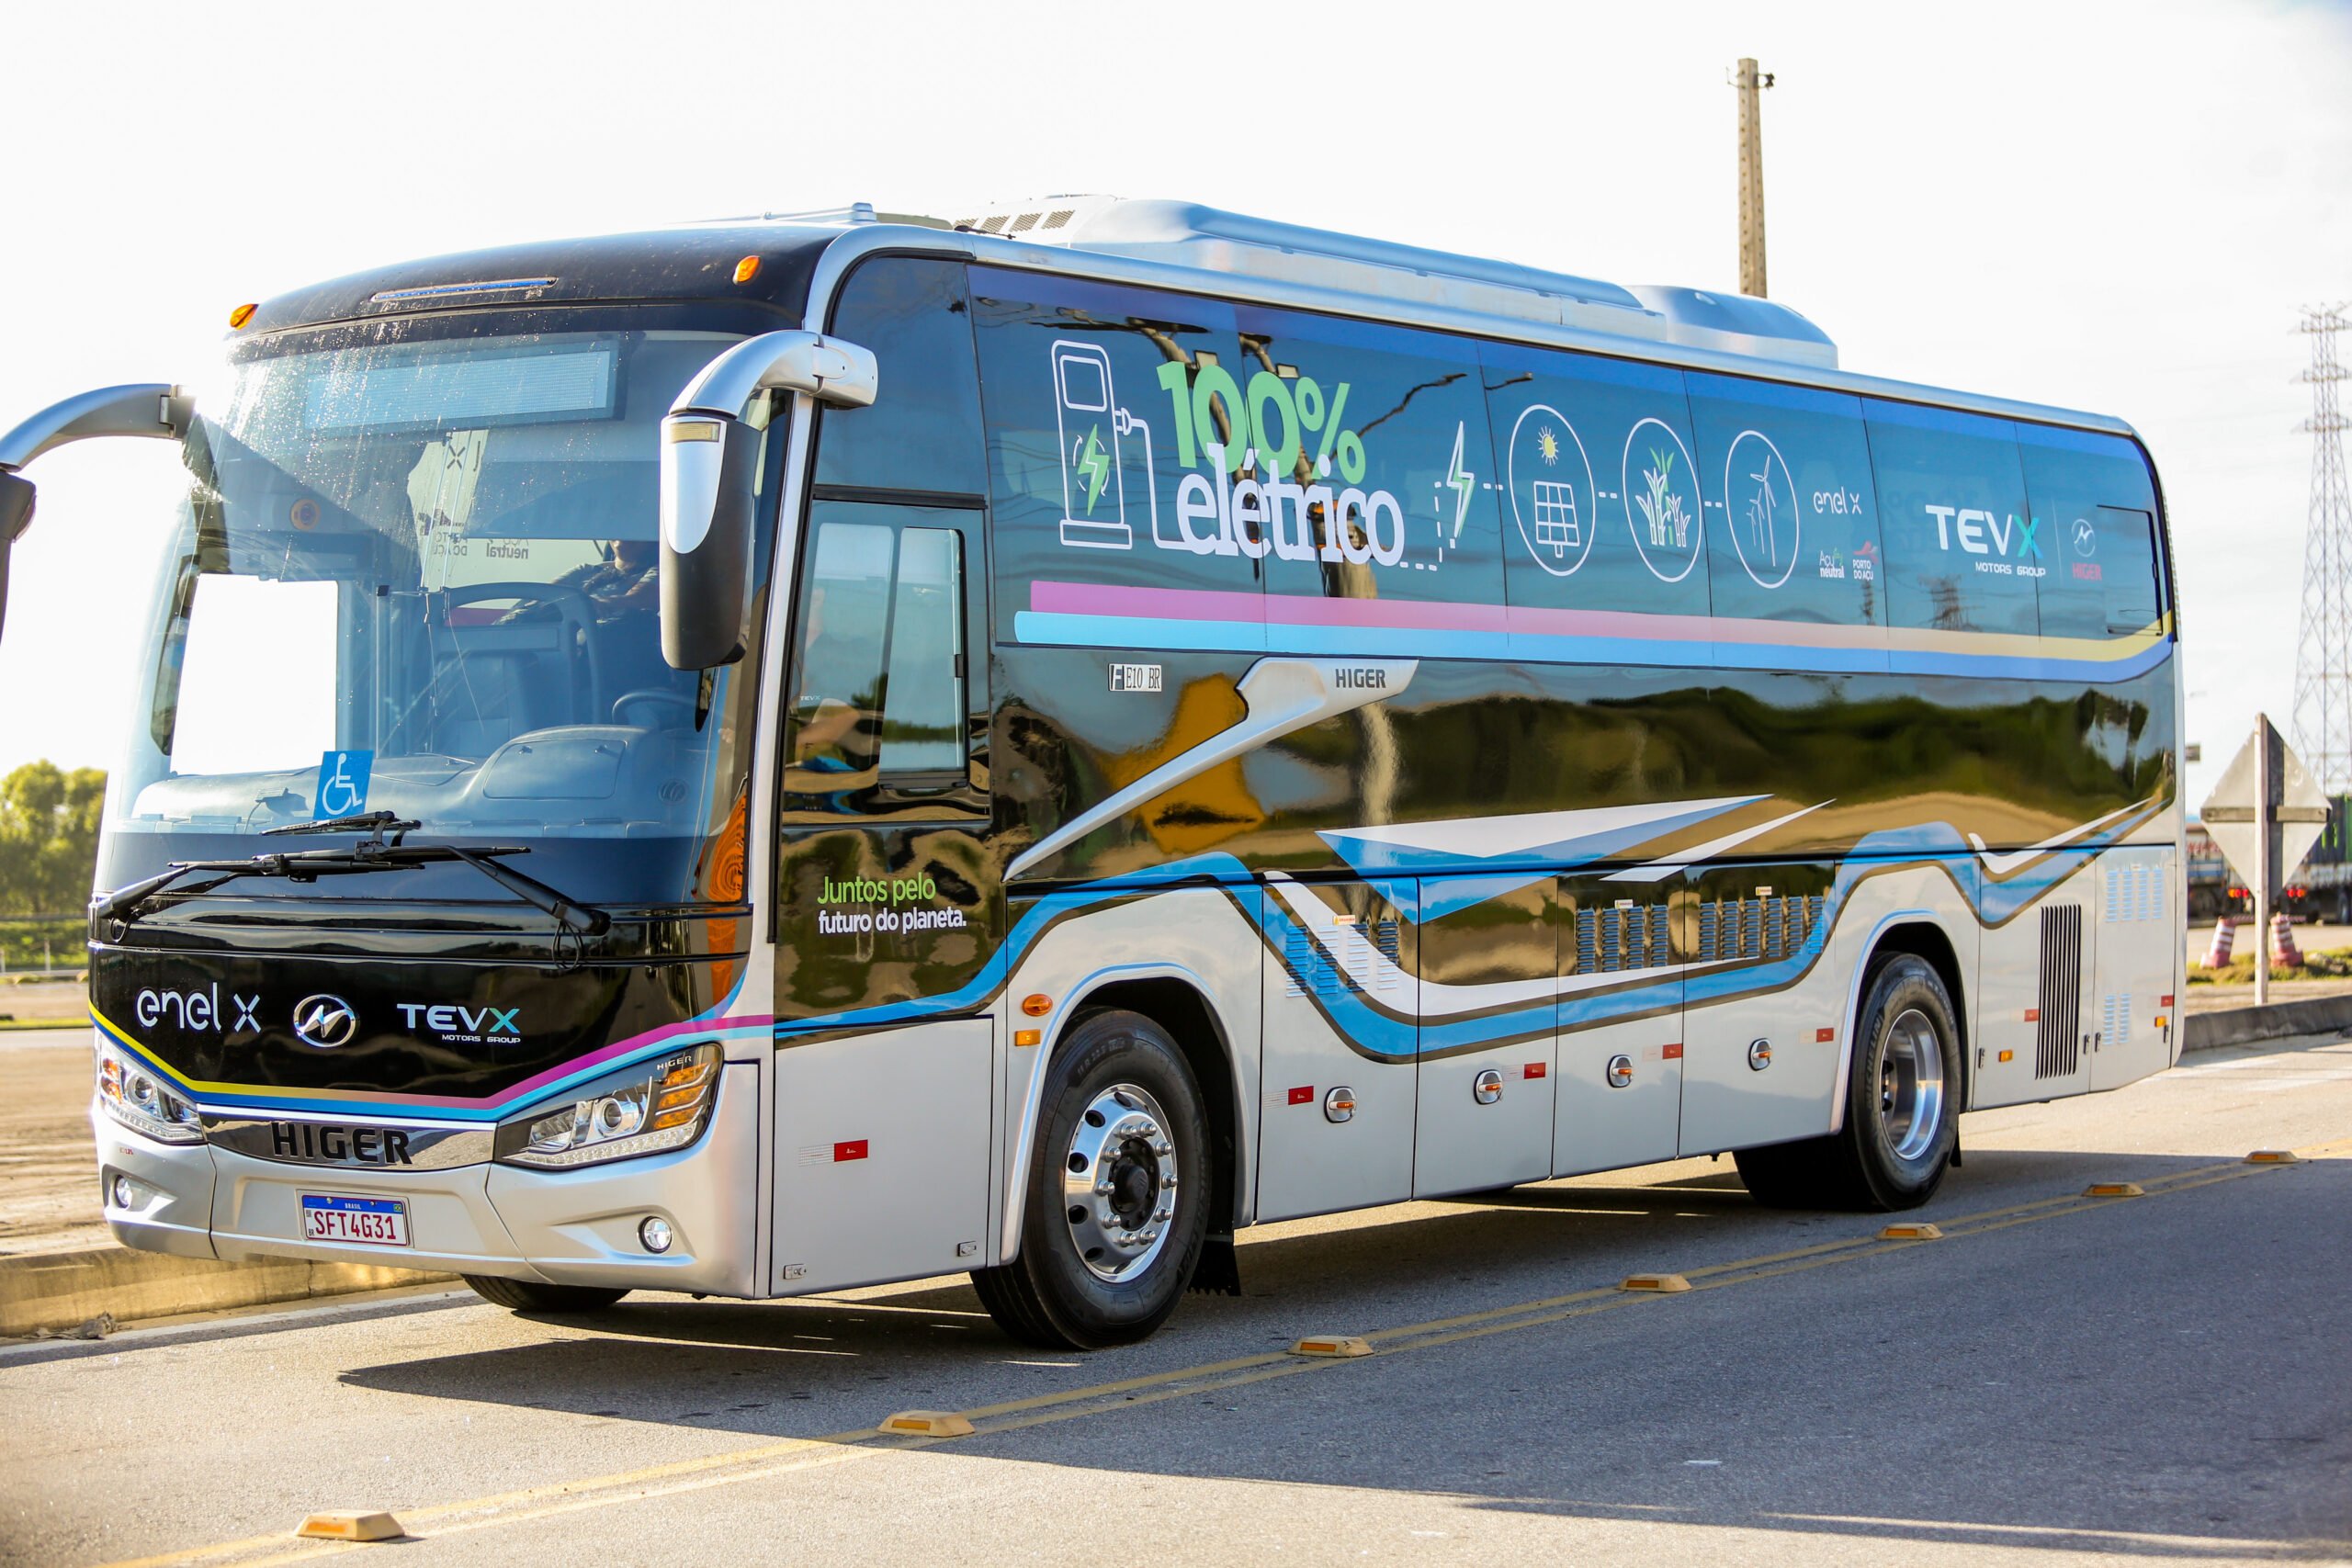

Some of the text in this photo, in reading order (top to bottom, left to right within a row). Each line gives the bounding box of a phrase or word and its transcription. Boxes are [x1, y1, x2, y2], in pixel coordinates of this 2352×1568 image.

[1157, 361, 1366, 484] 100%
[1177, 442, 1405, 567] elétrico
[1814, 486, 1848, 514] enel
[1926, 504, 2043, 558] TEVX
[1820, 566, 1845, 579] neutral
[1853, 559, 1871, 570] PORTO
[1854, 570, 1862, 580] DO
[1975, 562, 2046, 578] MOTORS GROUP
[2072, 562, 2102, 581] HIGER
[1148, 667, 1159, 689] BR
[1335, 668, 1386, 689] HIGER
[817, 872, 936, 907] Juntos pelo
[819, 906, 967, 935] futuro do planeta.
[137, 981, 222, 1032] enel
[396, 1003, 521, 1033] TEVX
[441, 1034, 481, 1043] MOTORS
[656, 1055, 692, 1071] HIGER
[1865, 1016, 1883, 1108] MICHELIN
[270, 1122, 413, 1165] HIGER
[313, 1211, 397, 1240] SFT4G31
